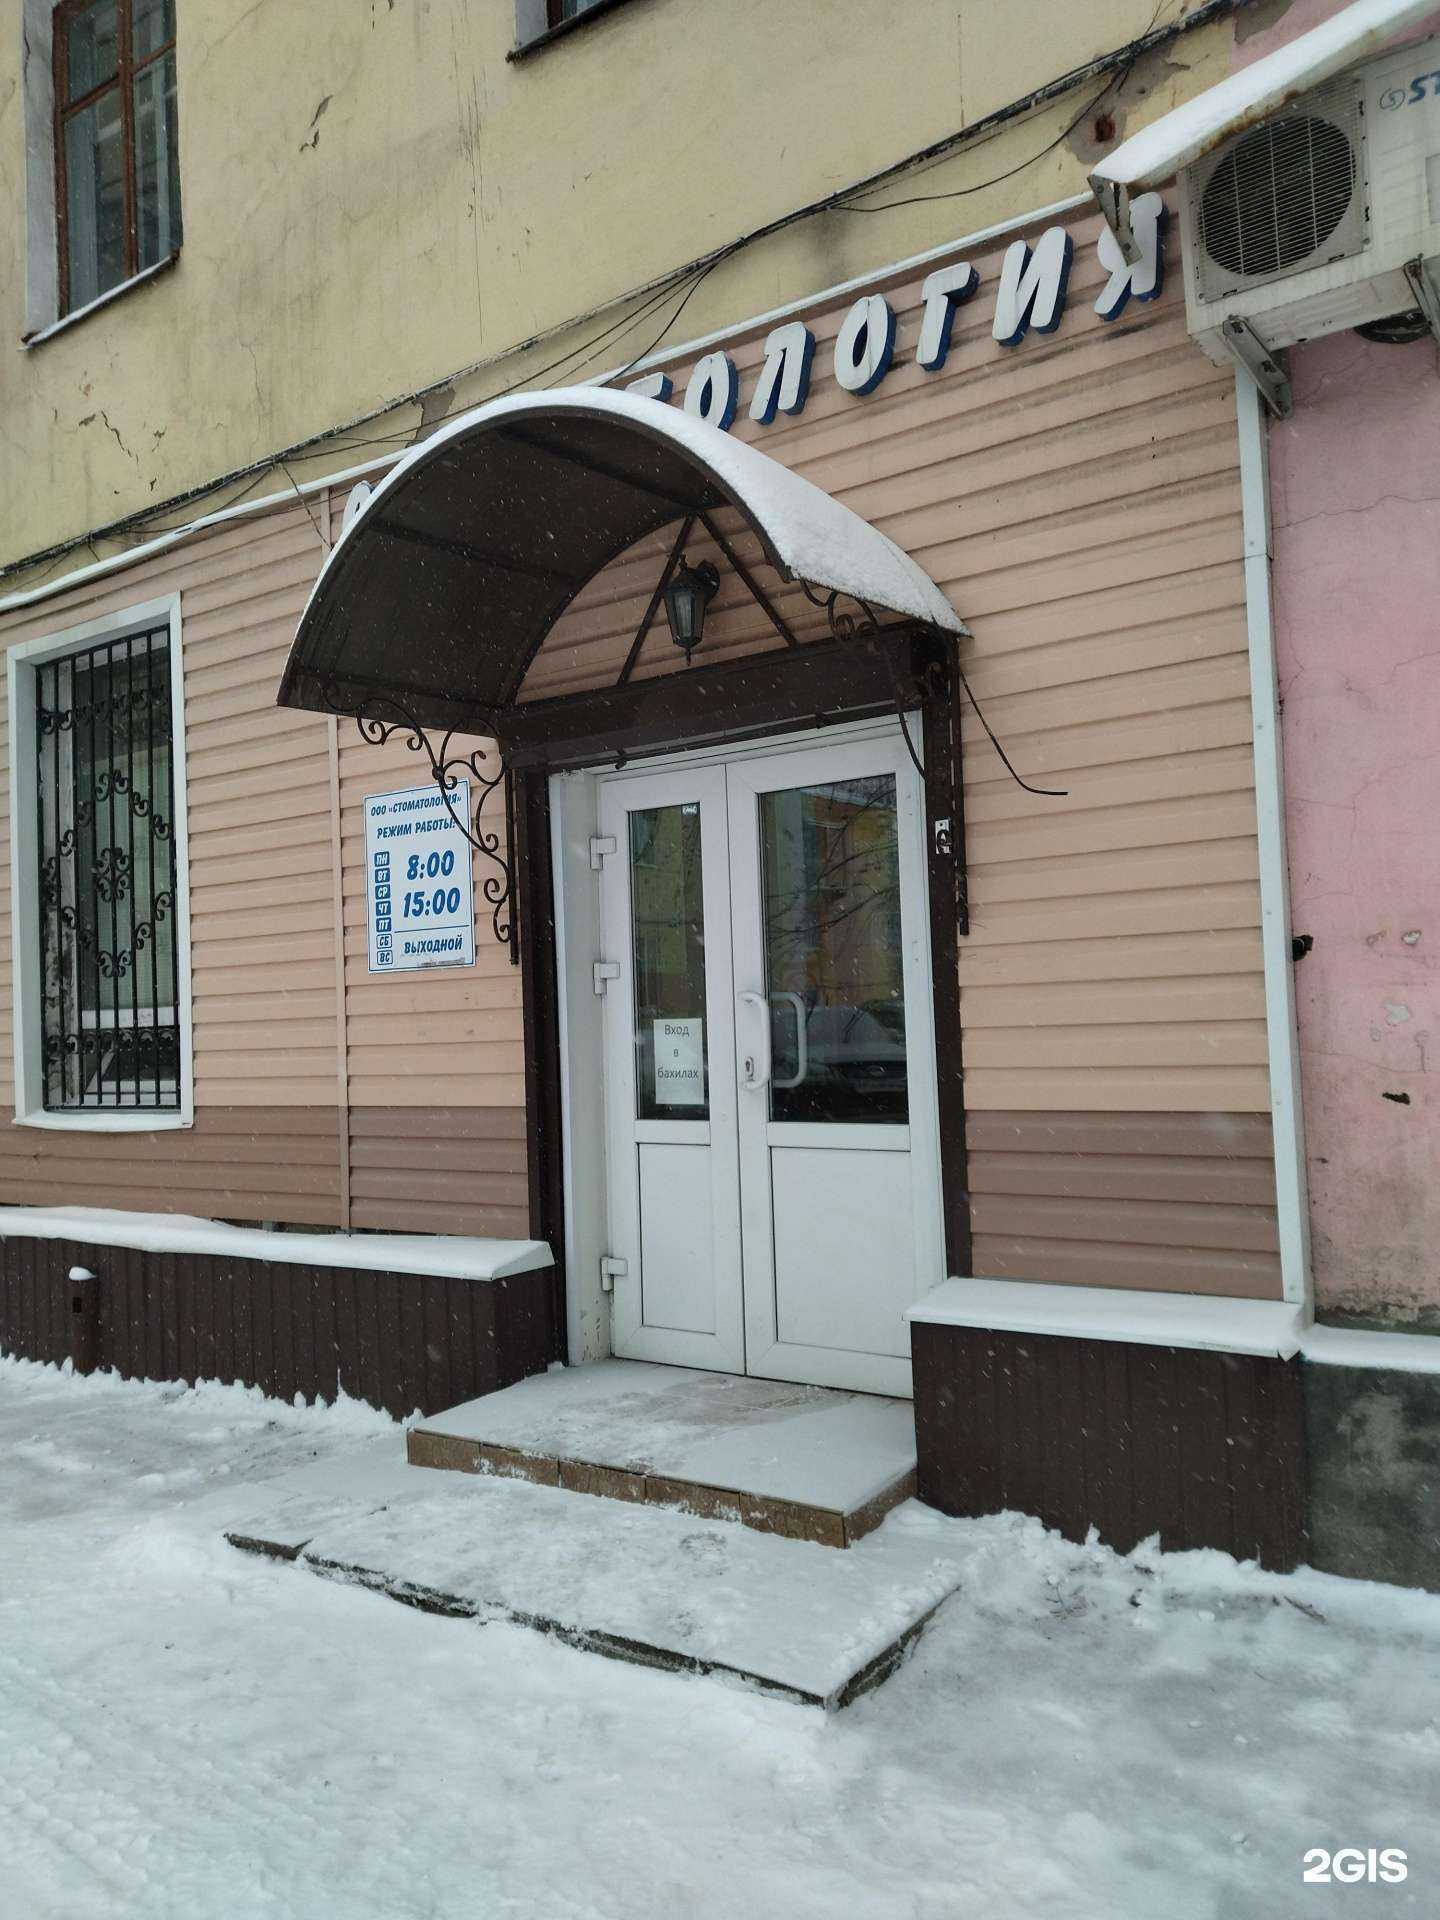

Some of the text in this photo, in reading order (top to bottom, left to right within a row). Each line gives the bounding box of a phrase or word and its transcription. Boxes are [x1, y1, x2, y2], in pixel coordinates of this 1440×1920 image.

[371, 805, 386, 816] ООО
[377, 823, 412, 839] РЕЖИМ
[376, 852, 388, 866] ПН
[407, 850, 455, 880] 8:00
[377, 870, 388, 882] ВТ
[378, 887, 388, 898] СР
[378, 903, 389, 914] ЧТ
[403, 887, 460, 918] 15:00
[378, 919, 390, 930] ПТ
[379, 936, 390, 946] СБ
[404, 934, 463, 954] ВЫХОДНОЙ
[379, 952, 390, 963] ВС
[664, 1024, 690, 1036] Вход
[673, 1048, 679, 1057] в
[657, 1066, 698, 1079] бахилах
